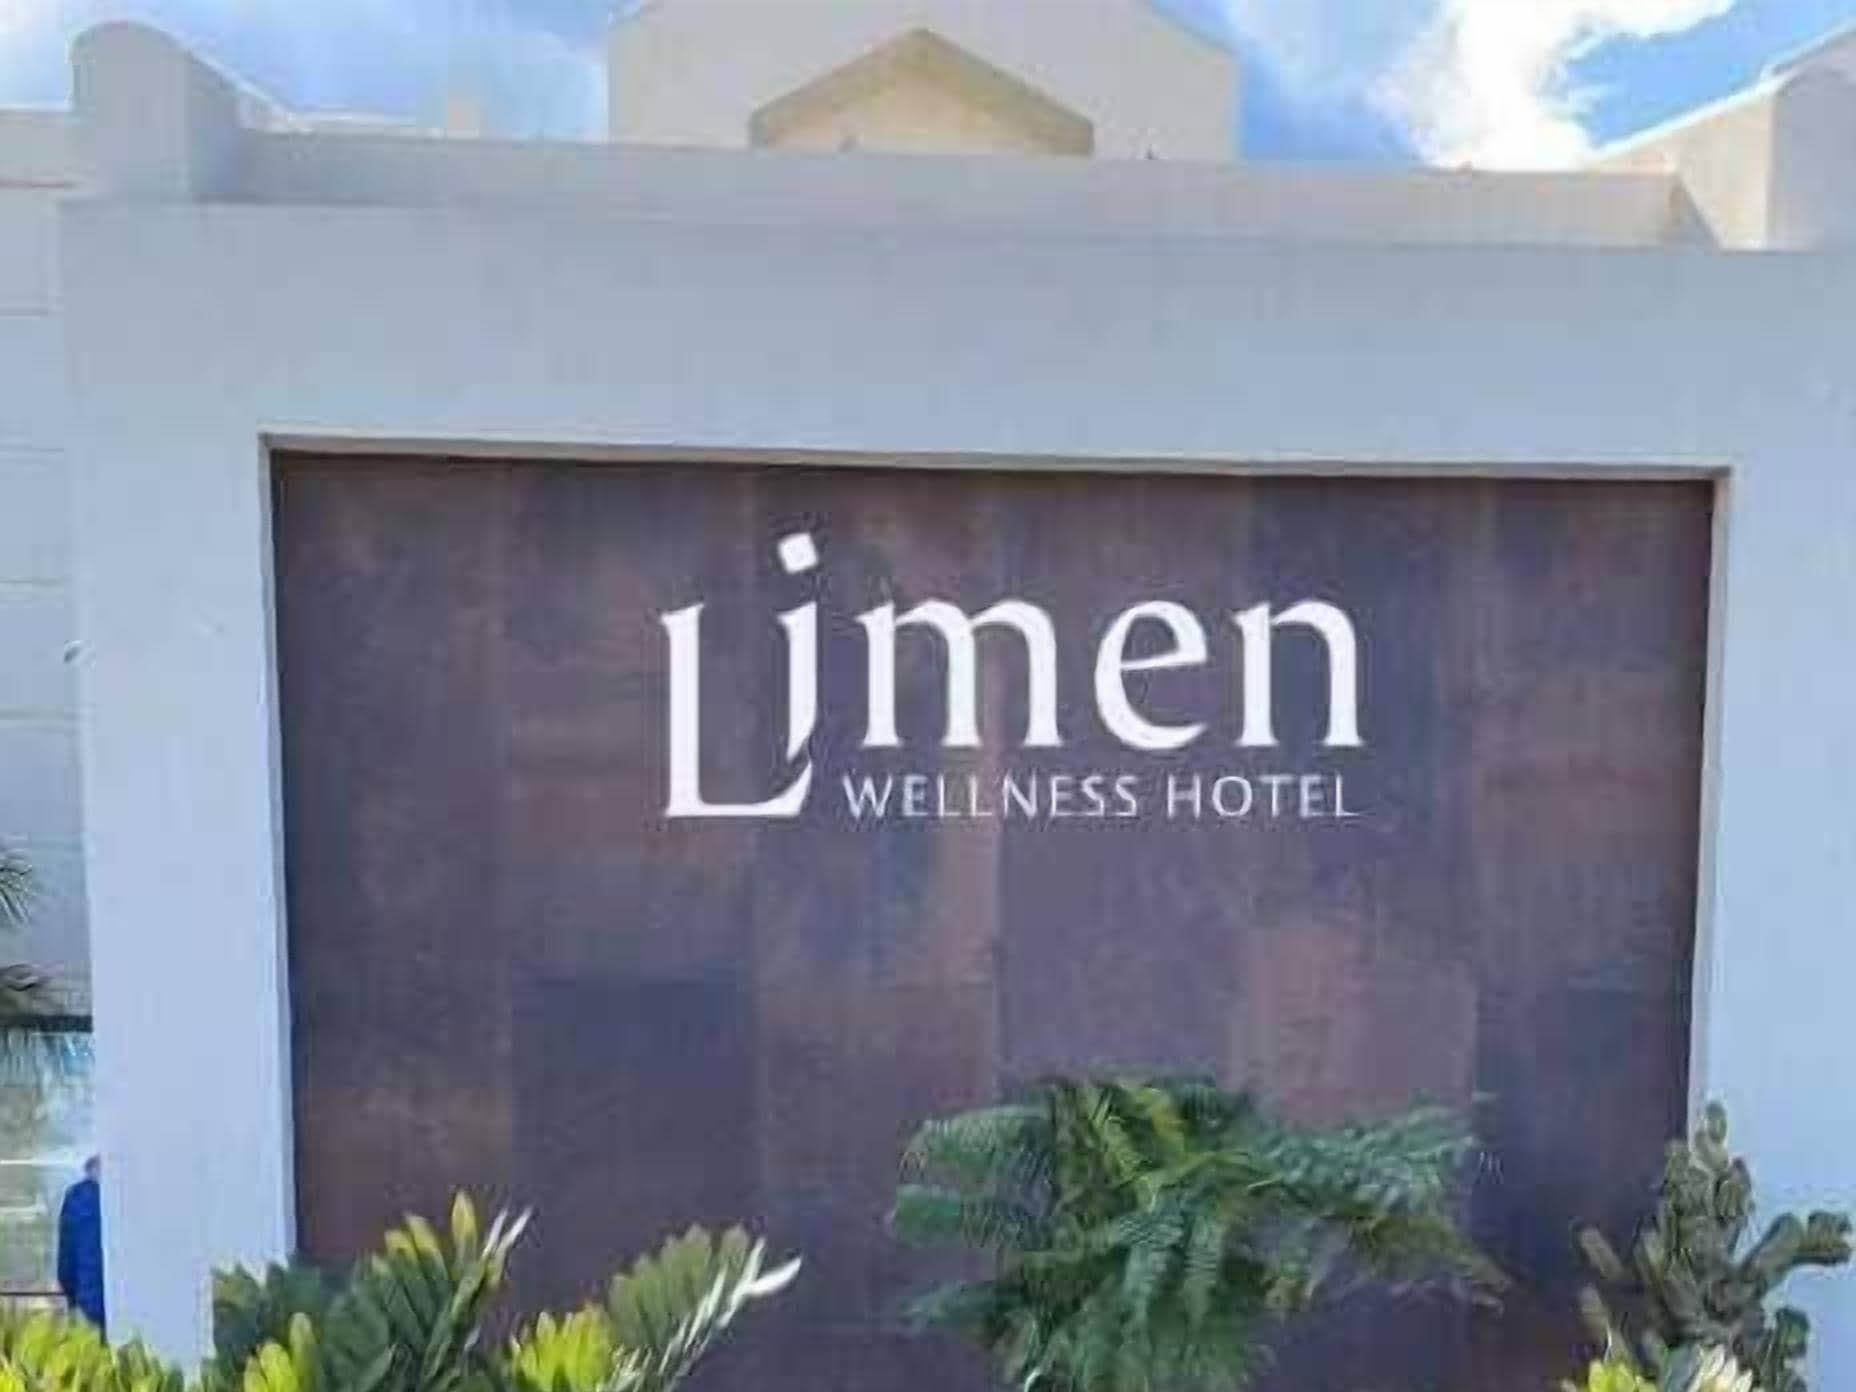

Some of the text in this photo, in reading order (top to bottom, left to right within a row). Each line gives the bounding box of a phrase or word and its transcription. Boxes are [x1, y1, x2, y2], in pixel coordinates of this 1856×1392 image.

[660, 532, 1365, 819] Limen
[842, 774, 1360, 819] WELLNESS HOTEL
